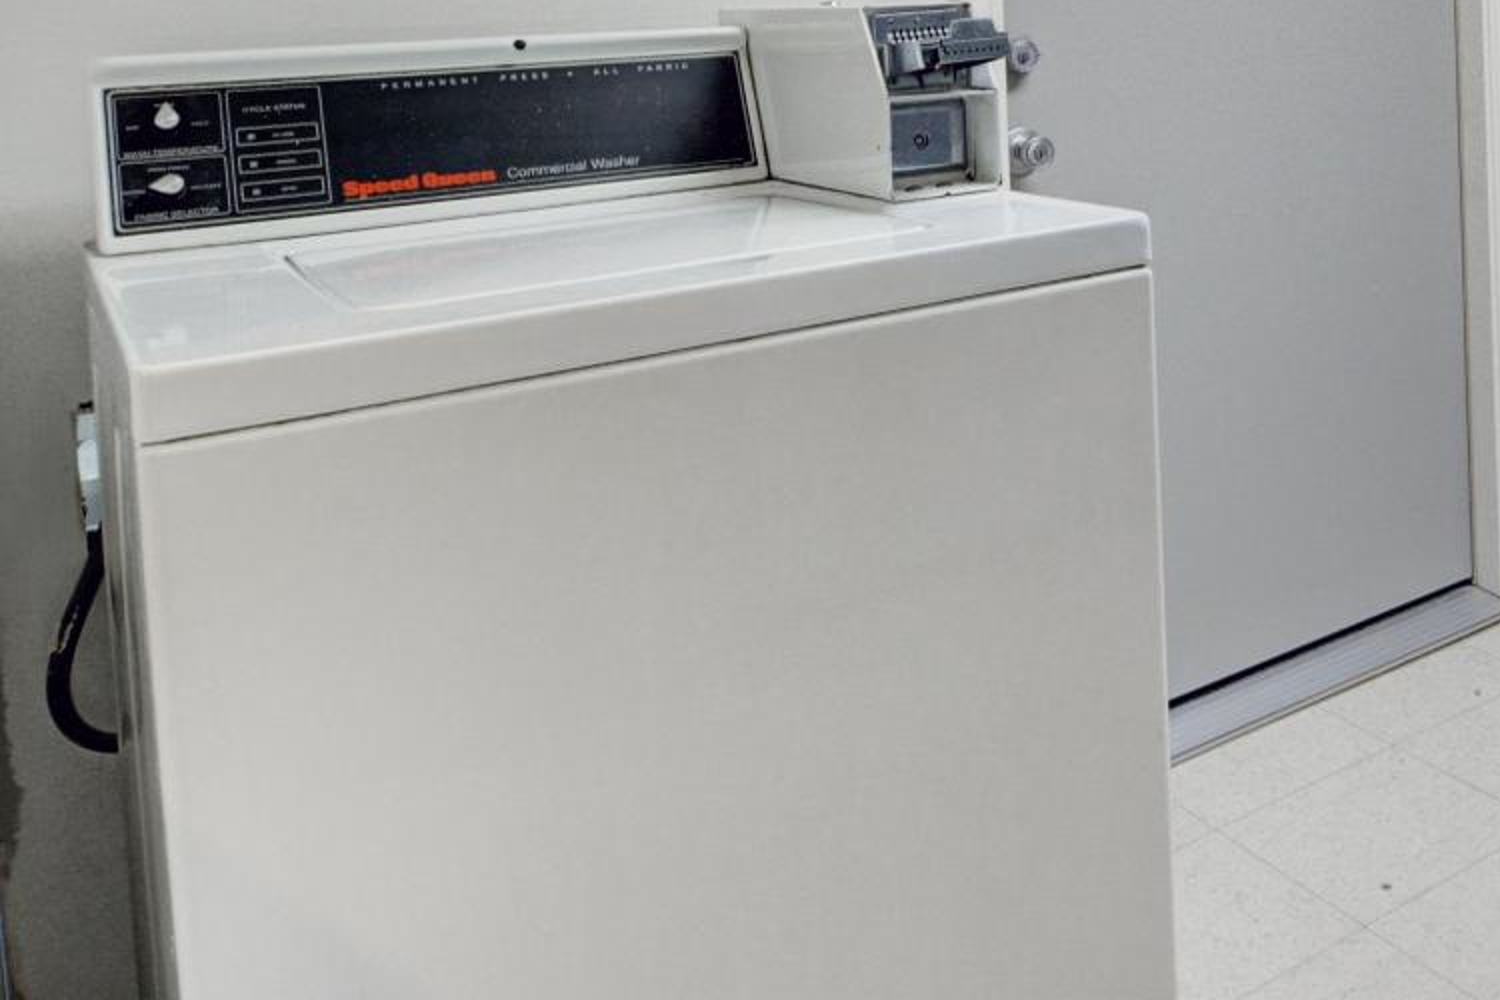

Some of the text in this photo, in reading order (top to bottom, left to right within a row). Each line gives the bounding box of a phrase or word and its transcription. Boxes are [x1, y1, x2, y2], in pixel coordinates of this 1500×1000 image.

[342, 154, 641, 200] Speed Queen Commercial Washer
